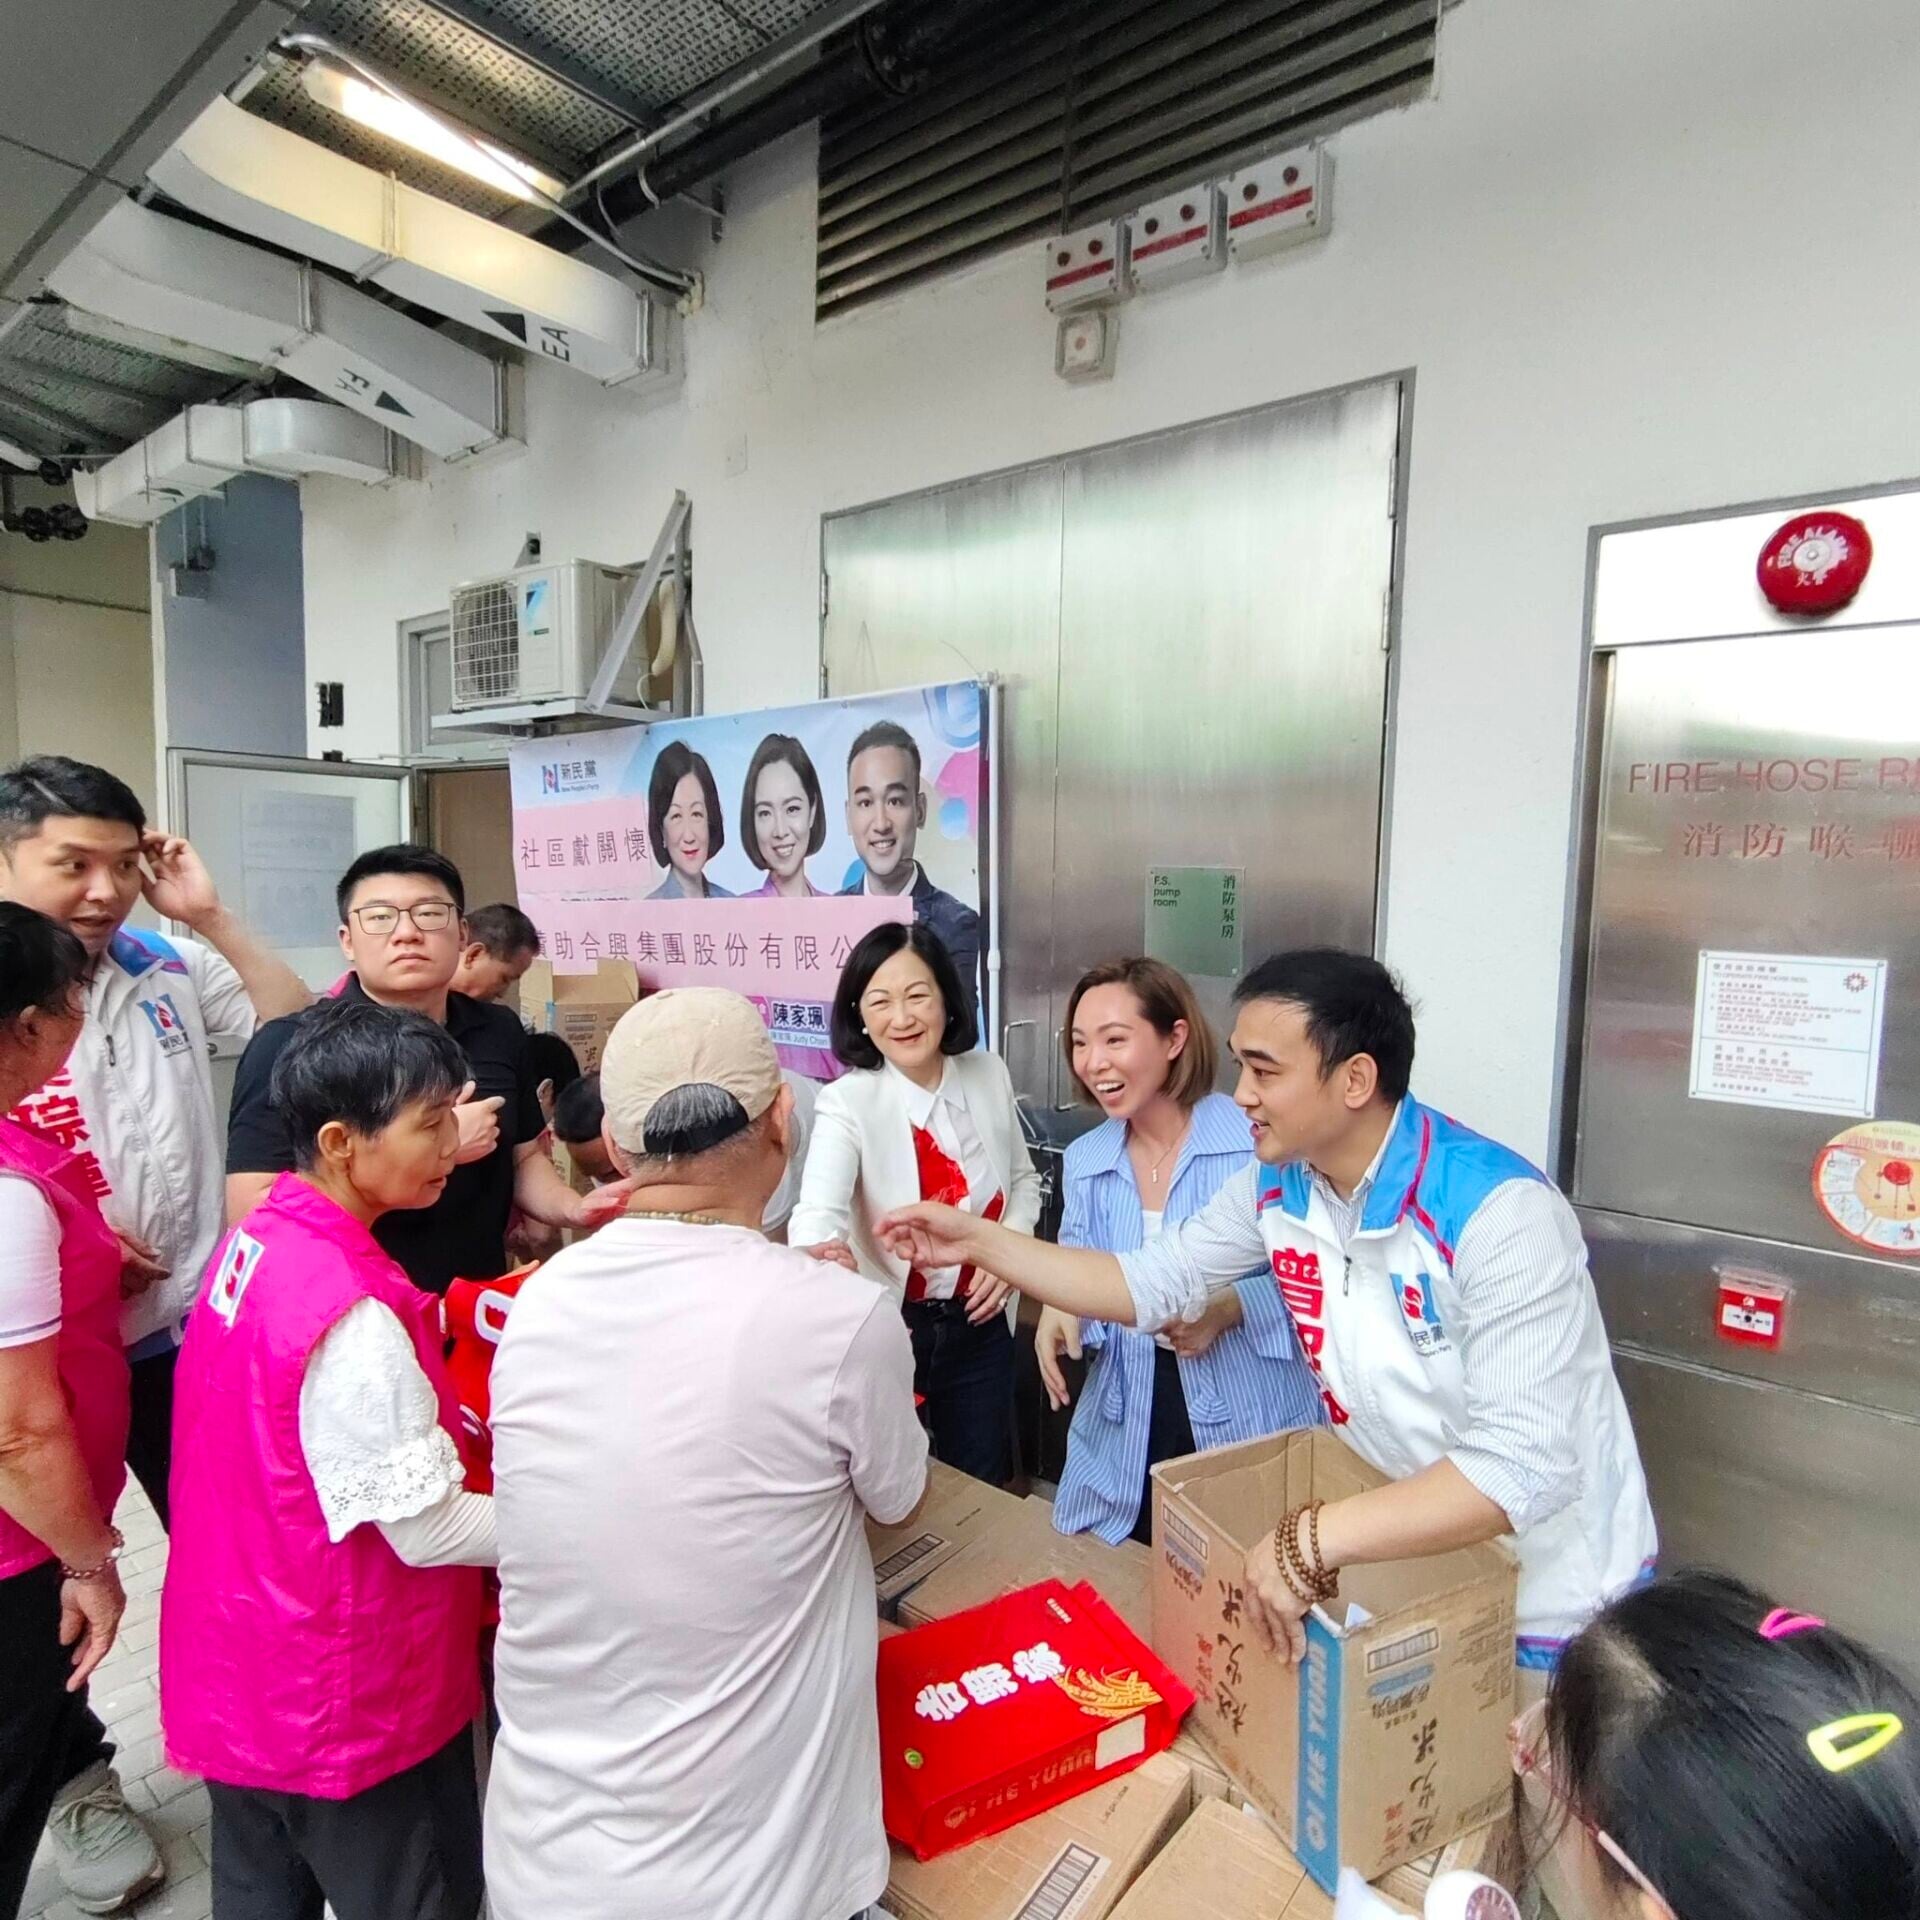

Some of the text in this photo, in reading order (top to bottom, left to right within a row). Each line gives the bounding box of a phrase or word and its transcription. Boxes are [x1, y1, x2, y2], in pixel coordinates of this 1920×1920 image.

[1629, 757, 1920, 793] FIRE HOSE R
[521, 827, 648, 870] 社區獻關懷
[1153, 888, 1181, 898] pump
[1153, 898, 1177, 907] room
[773, 1003, 825, 1030] 陳家珮
